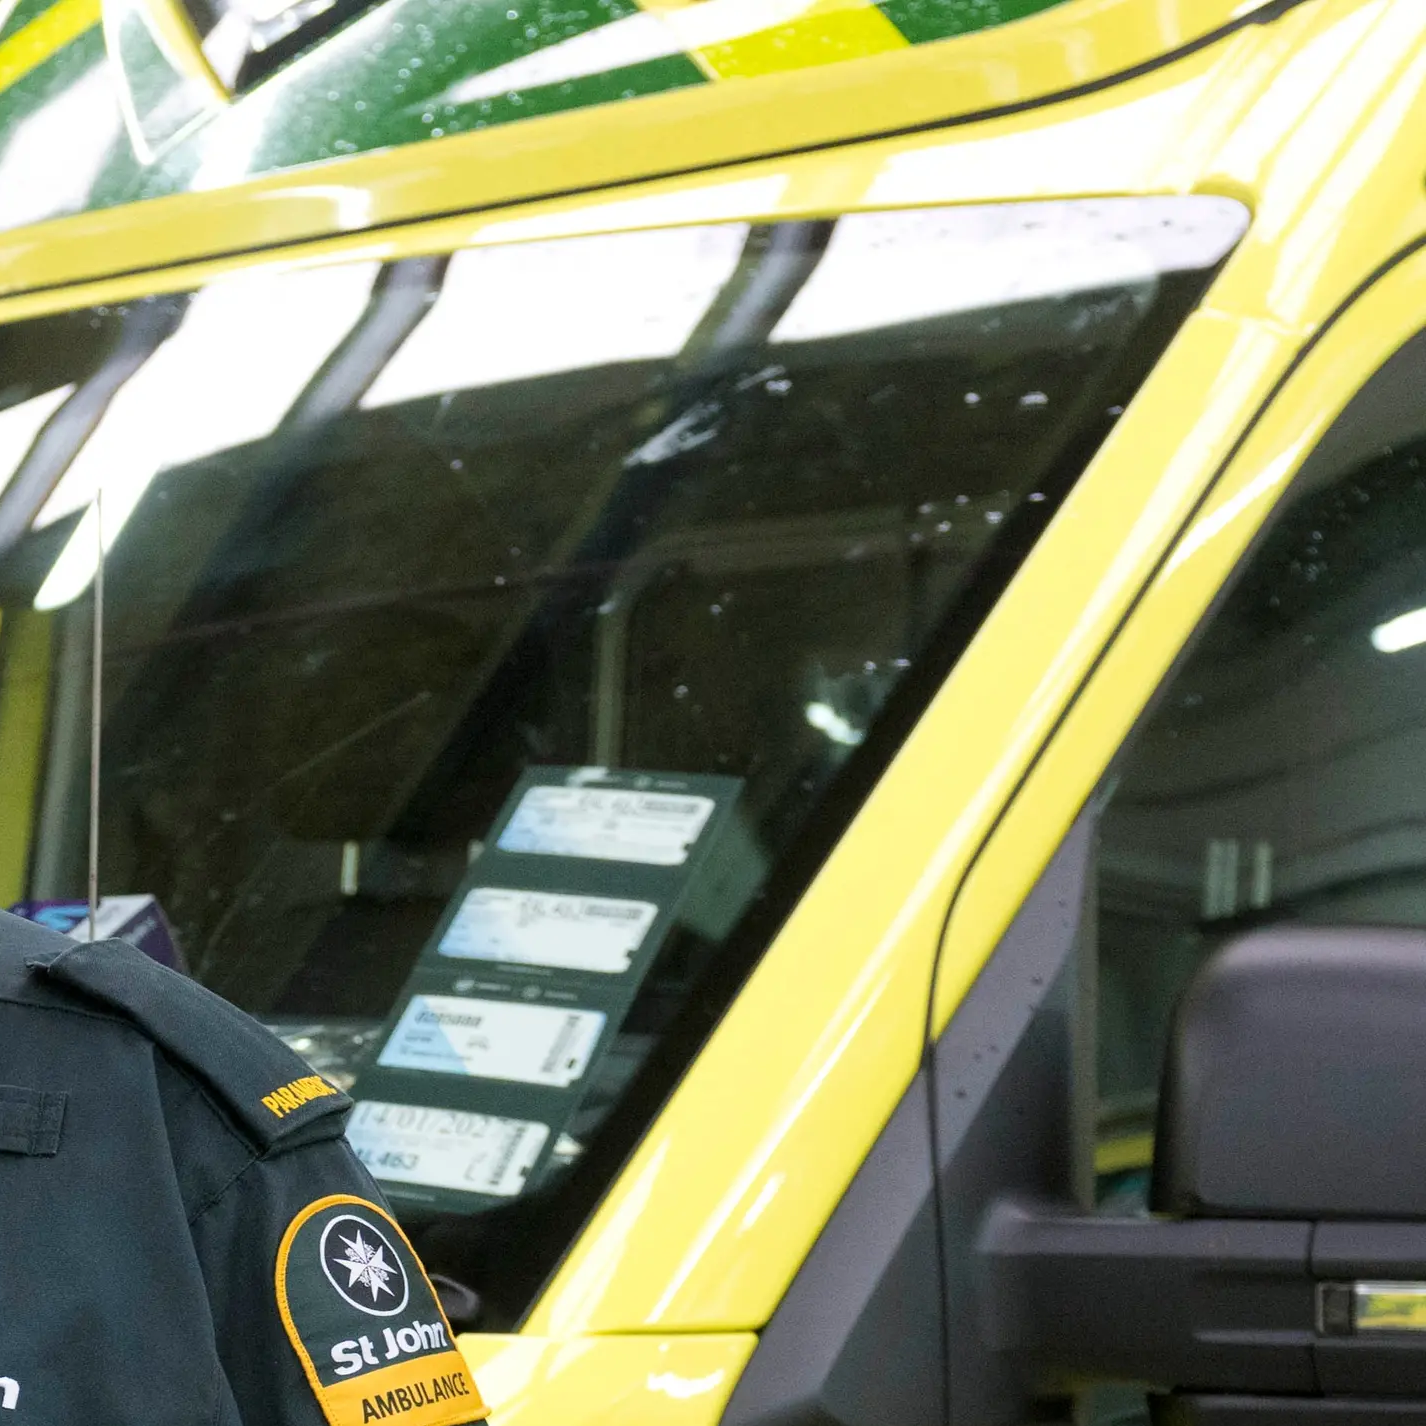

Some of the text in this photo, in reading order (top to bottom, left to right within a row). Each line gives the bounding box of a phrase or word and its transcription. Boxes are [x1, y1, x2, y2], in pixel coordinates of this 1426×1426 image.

[331, 1320, 448, 1376] St John
[361, 1373, 470, 1424] AMBULANCE
